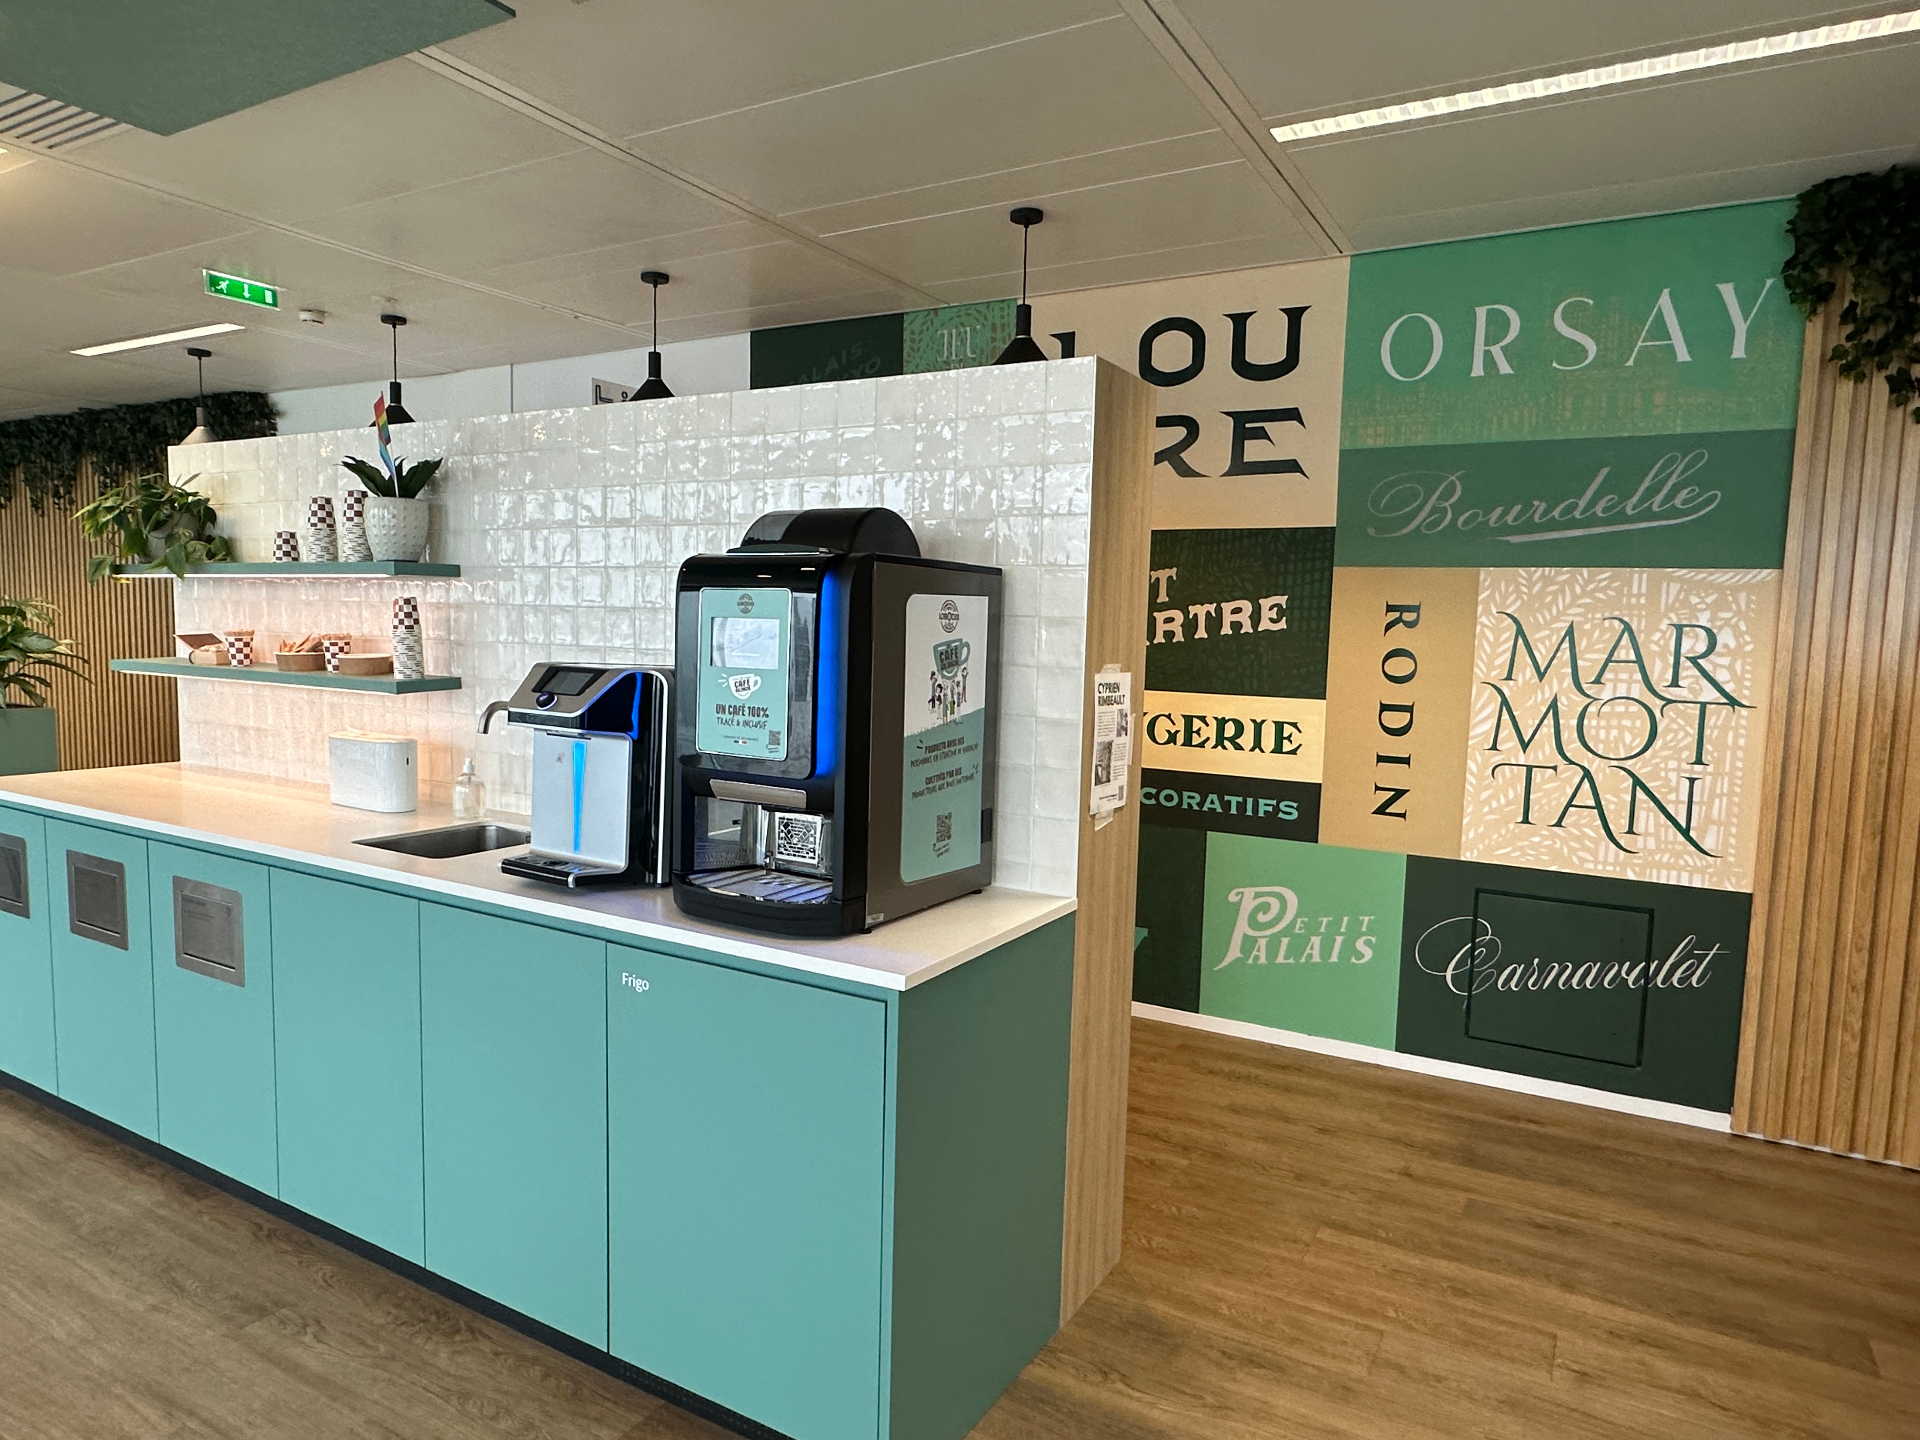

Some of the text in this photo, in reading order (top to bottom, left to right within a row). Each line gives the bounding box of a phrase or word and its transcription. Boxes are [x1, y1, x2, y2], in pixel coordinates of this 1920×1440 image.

[1380, 278, 1776, 381] ORSAY
[1367, 449, 1721, 543] Bourdelle
[1496, 611, 1757, 707] MAR
[747, 706, 769, 718] 100%
[1371, 600, 1422, 821] RODIN
[1480, 681, 1736, 767] MOT
[1491, 763, 1723, 858] TAN
[621, 972, 650, 993] Frigo
[1415, 916, 1732, 996] Carnavalet
